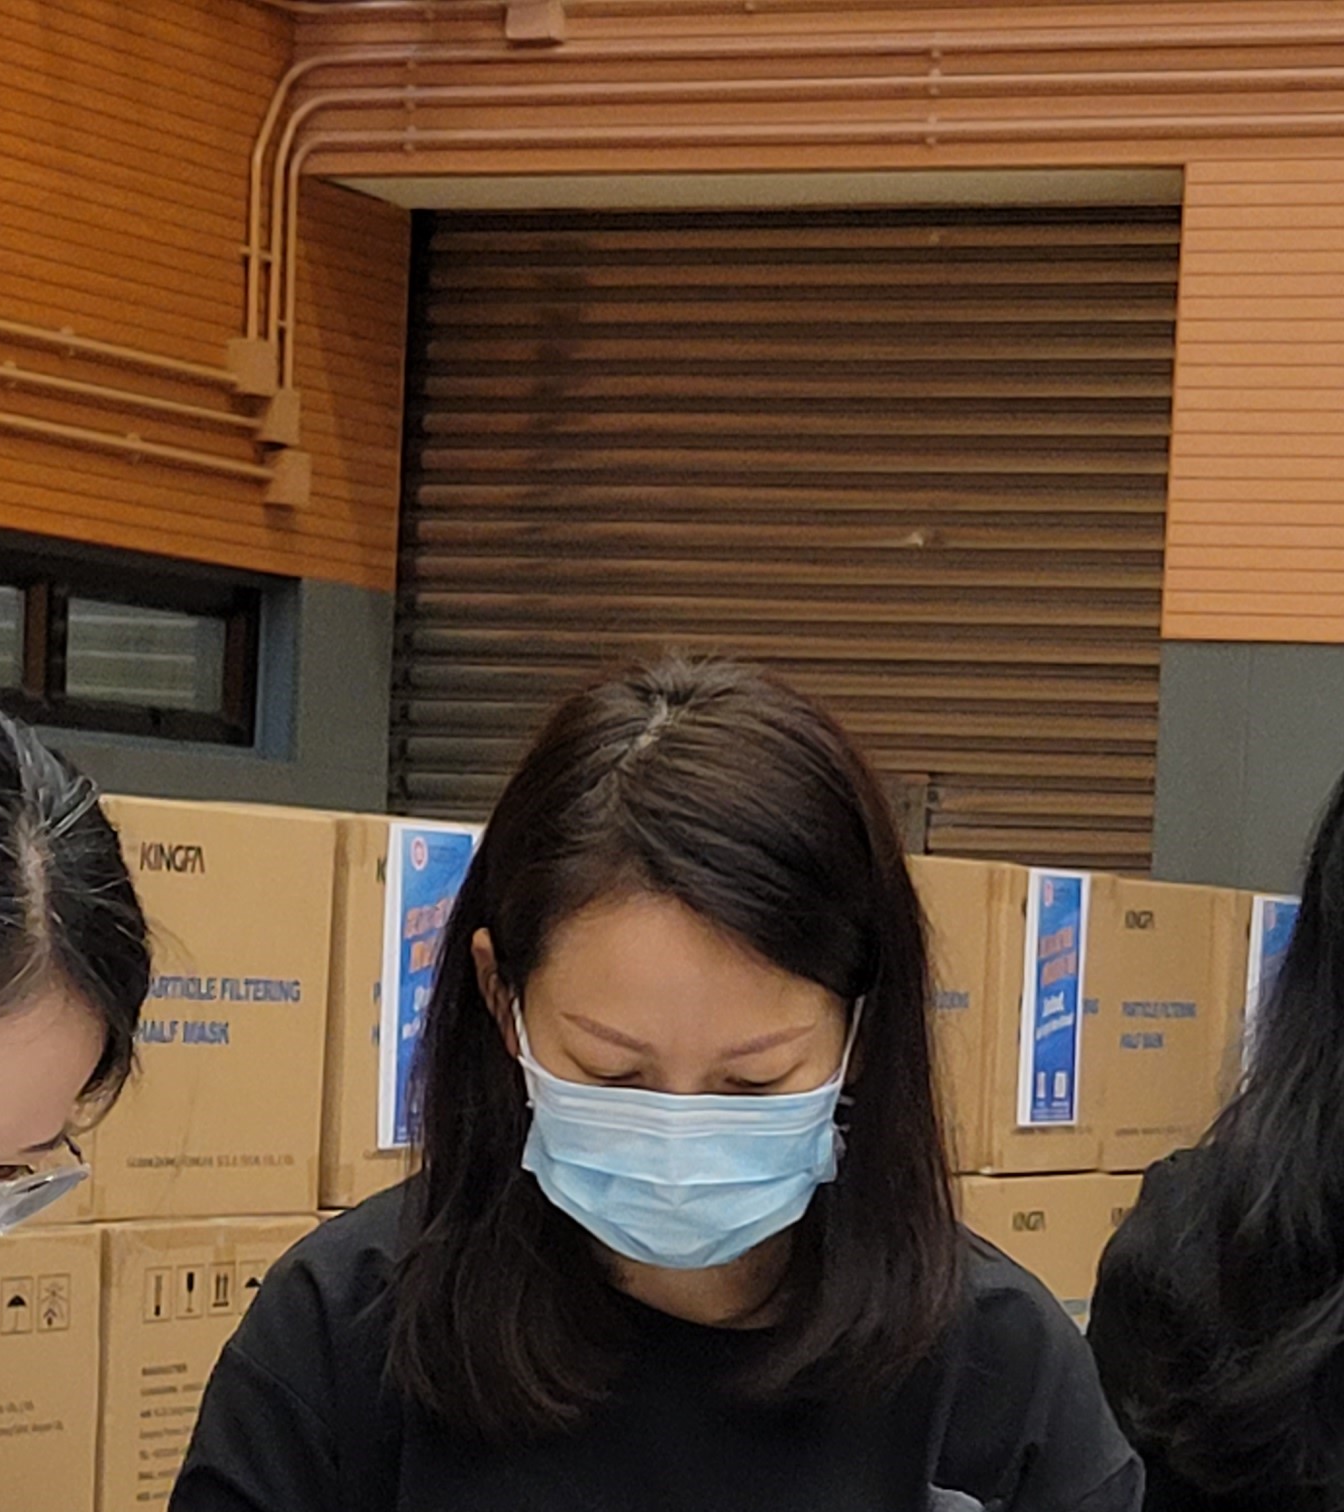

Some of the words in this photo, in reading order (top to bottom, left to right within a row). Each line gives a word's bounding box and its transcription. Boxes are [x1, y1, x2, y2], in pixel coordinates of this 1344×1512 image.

[139, 842, 205, 874] KINGFA
[150, 976, 217, 1001] ARTICLE
[220, 977, 301, 1003] FILTERING
[136, 1019, 179, 1044] HALF
[183, 1020, 229, 1045] MASK
